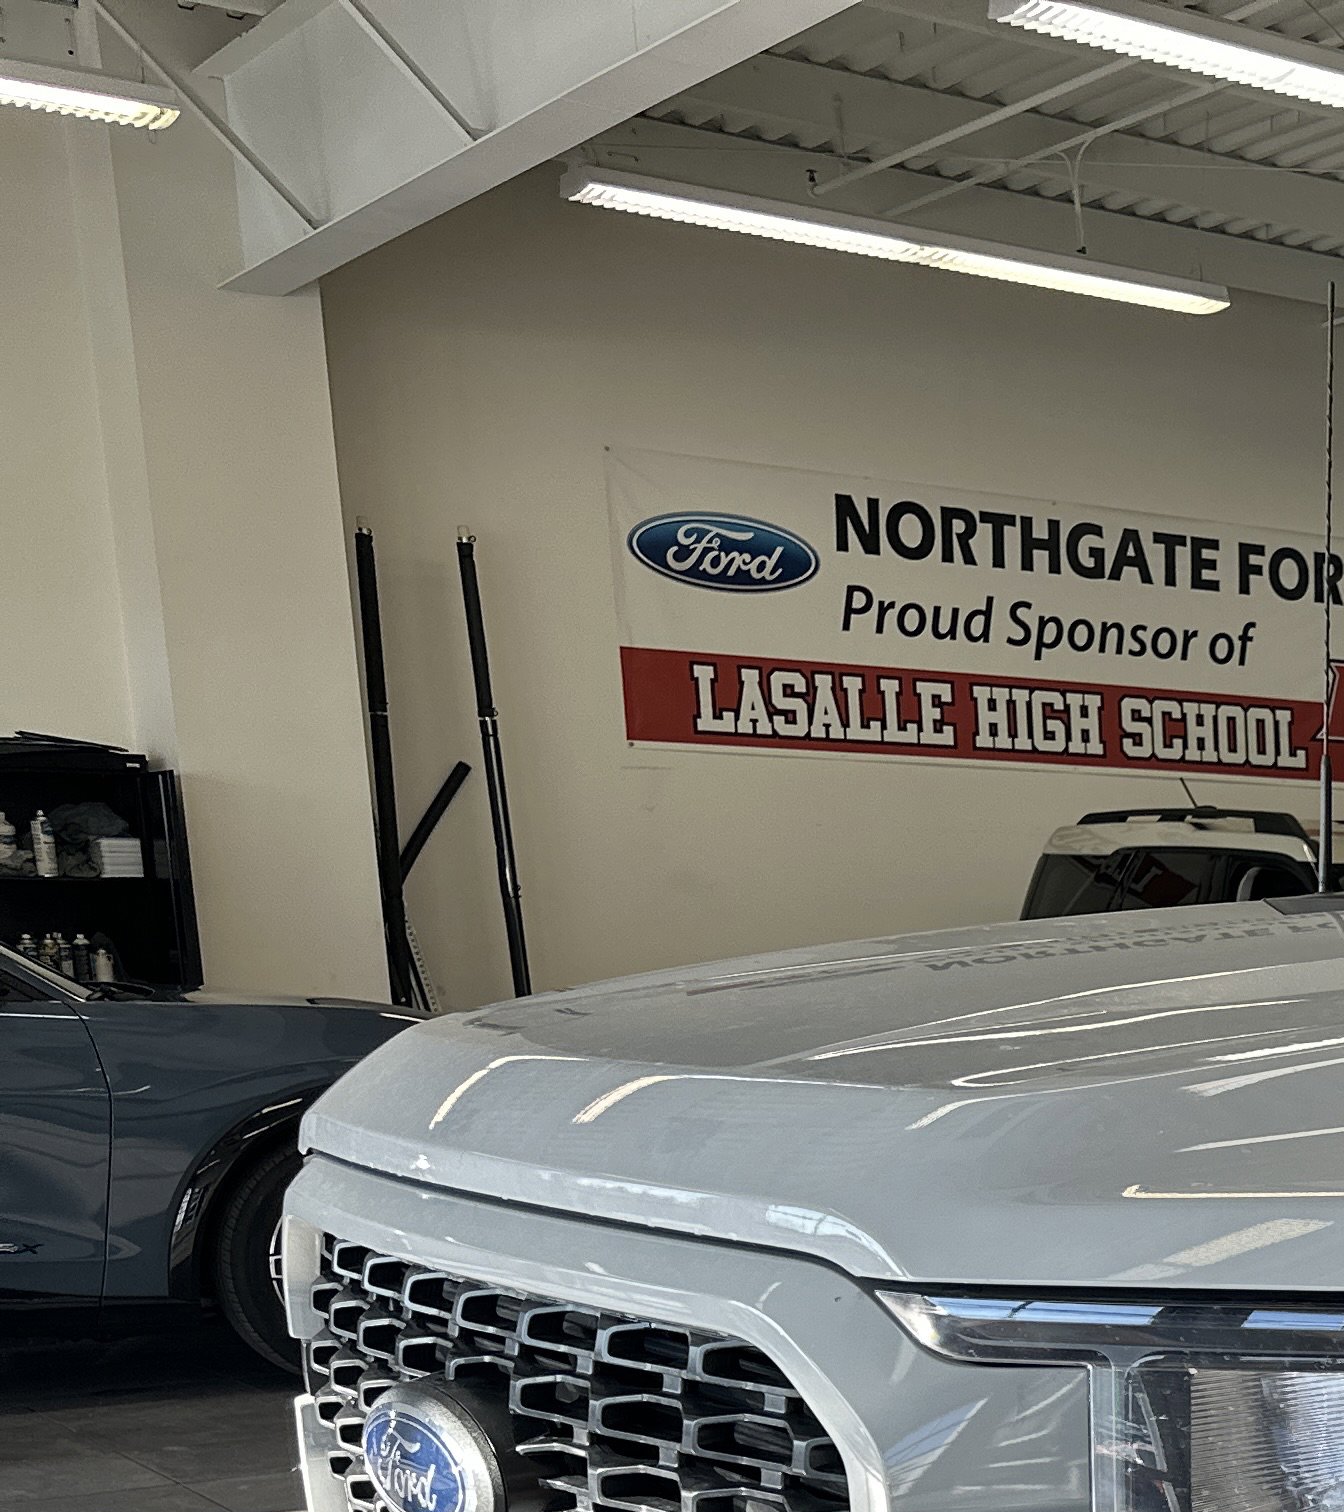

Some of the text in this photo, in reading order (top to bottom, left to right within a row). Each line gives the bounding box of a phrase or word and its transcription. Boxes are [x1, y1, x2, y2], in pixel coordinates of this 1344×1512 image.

[665, 522, 784, 582] Ford
[834, 493, 1221, 592] NORTHGATE
[841, 584, 1257, 666] Proud Sponsor of
[689, 661, 1308, 770] LASALLE HIGH SCHOOL
[377, 1426, 437, 1511] Ford
